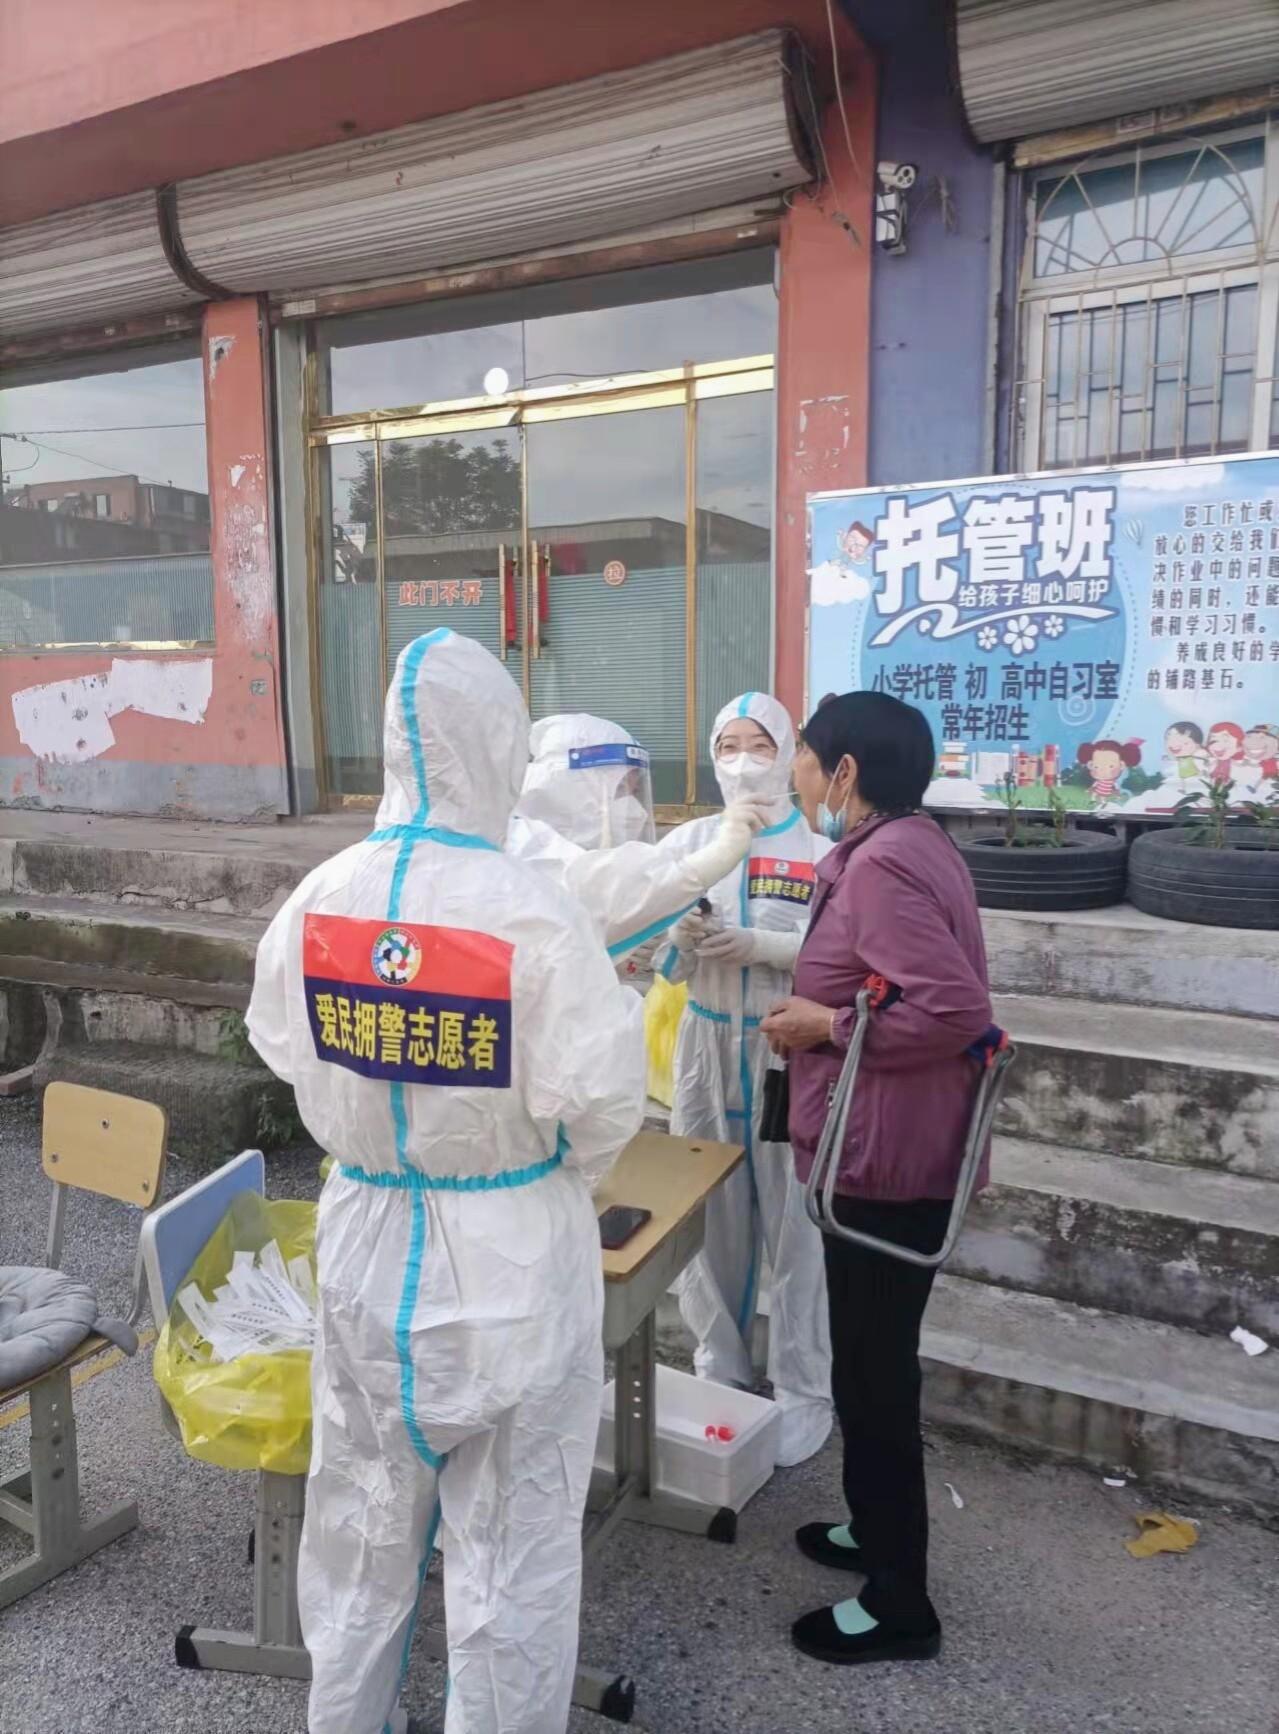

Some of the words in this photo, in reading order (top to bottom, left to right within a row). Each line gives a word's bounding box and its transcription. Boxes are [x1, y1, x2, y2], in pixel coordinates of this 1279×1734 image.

[873, 488, 1116, 614] 托管班
[399, 580, 483, 606] 此门不开
[959, 579, 1108, 607] 给孩子细心呵护
[872, 662, 957, 700] 小学托管
[965, 663, 989, 700] 初
[1001, 659, 1120, 700] 高中自习室
[941, 703, 1030, 741] 常年招生
[315, 993, 498, 1070] 爱民拥警志愿者
